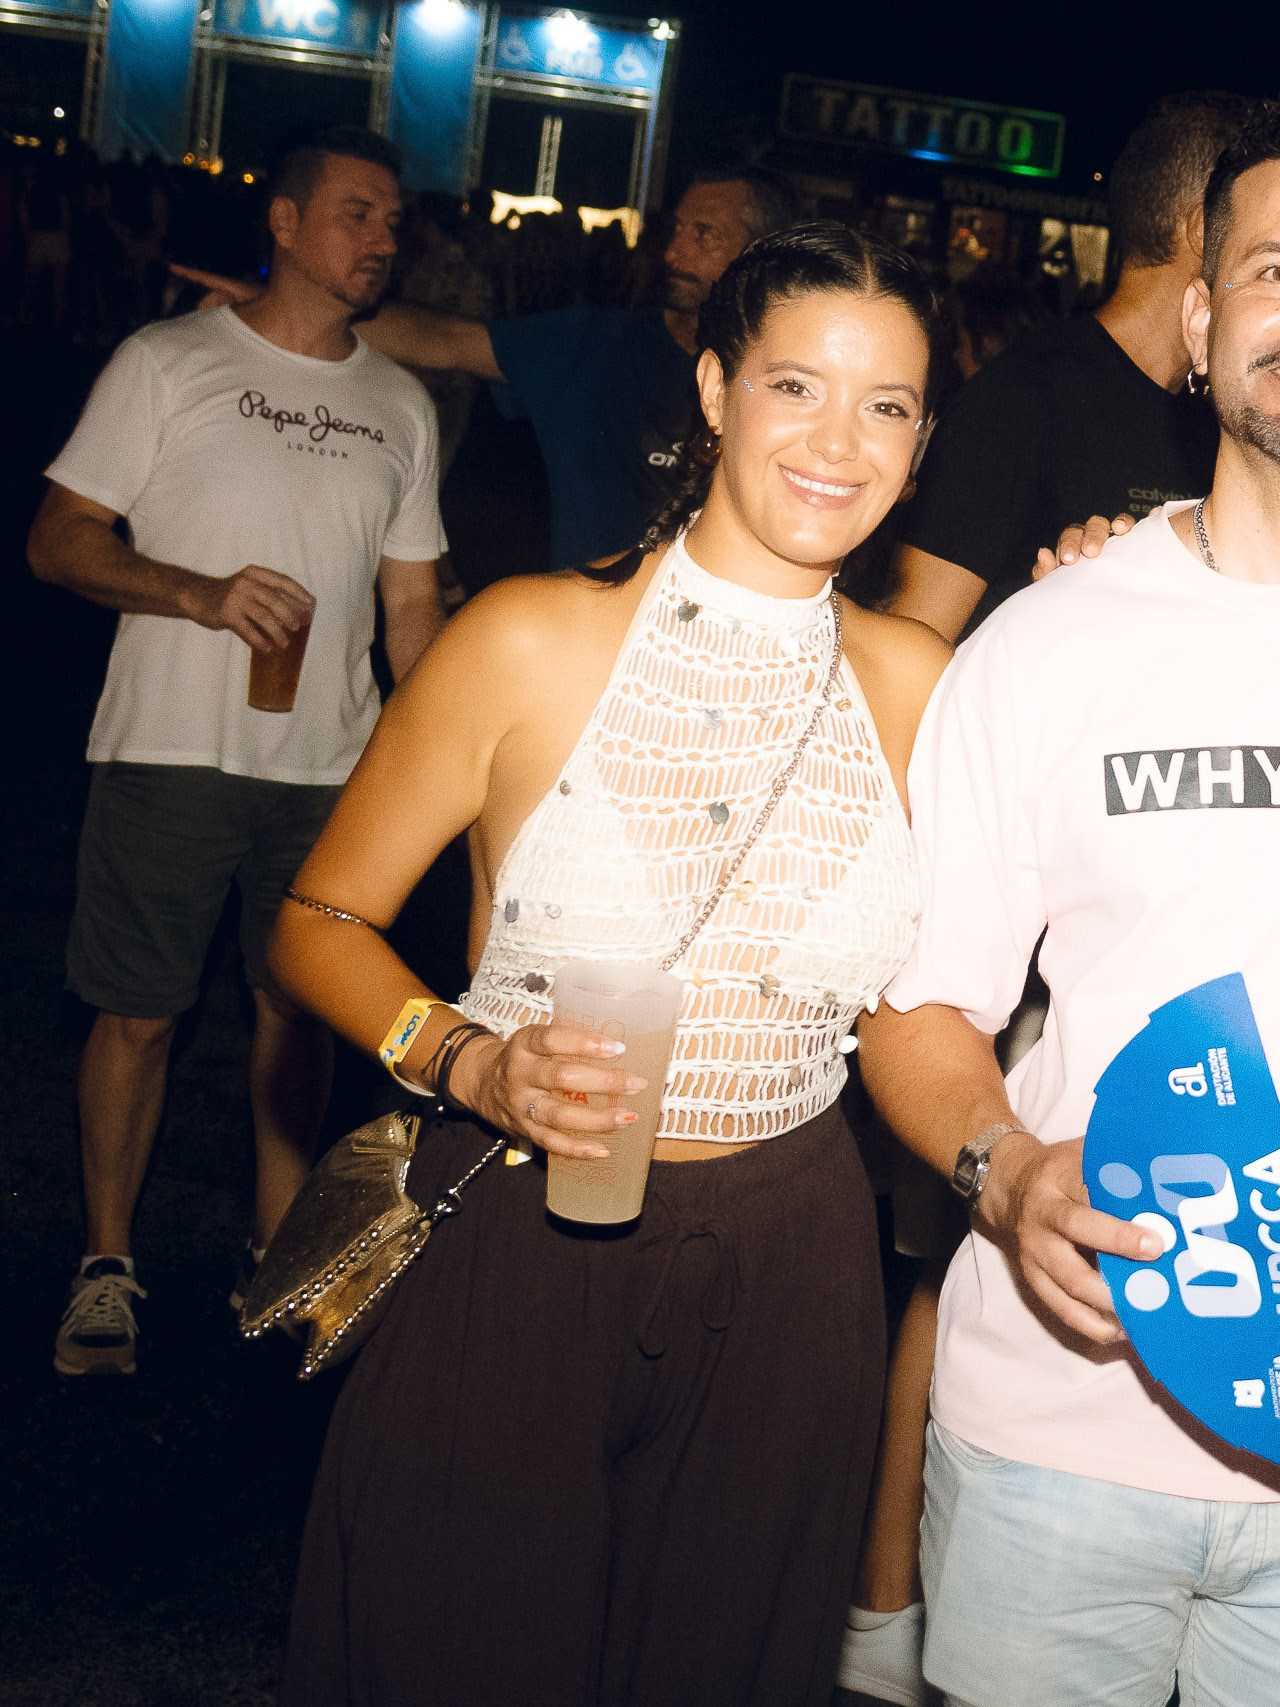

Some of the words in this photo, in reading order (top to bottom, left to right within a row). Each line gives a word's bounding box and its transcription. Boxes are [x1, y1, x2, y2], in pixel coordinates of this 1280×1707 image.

[257, 0, 339, 39] WC
[811, 87, 1035, 162] TATTOO
[239, 390, 308, 433] Pepe
[309, 405, 385, 443] Jeans
[287, 441, 349, 459] LONDON
[1217, 1046, 1234, 1092] ALICANTE
